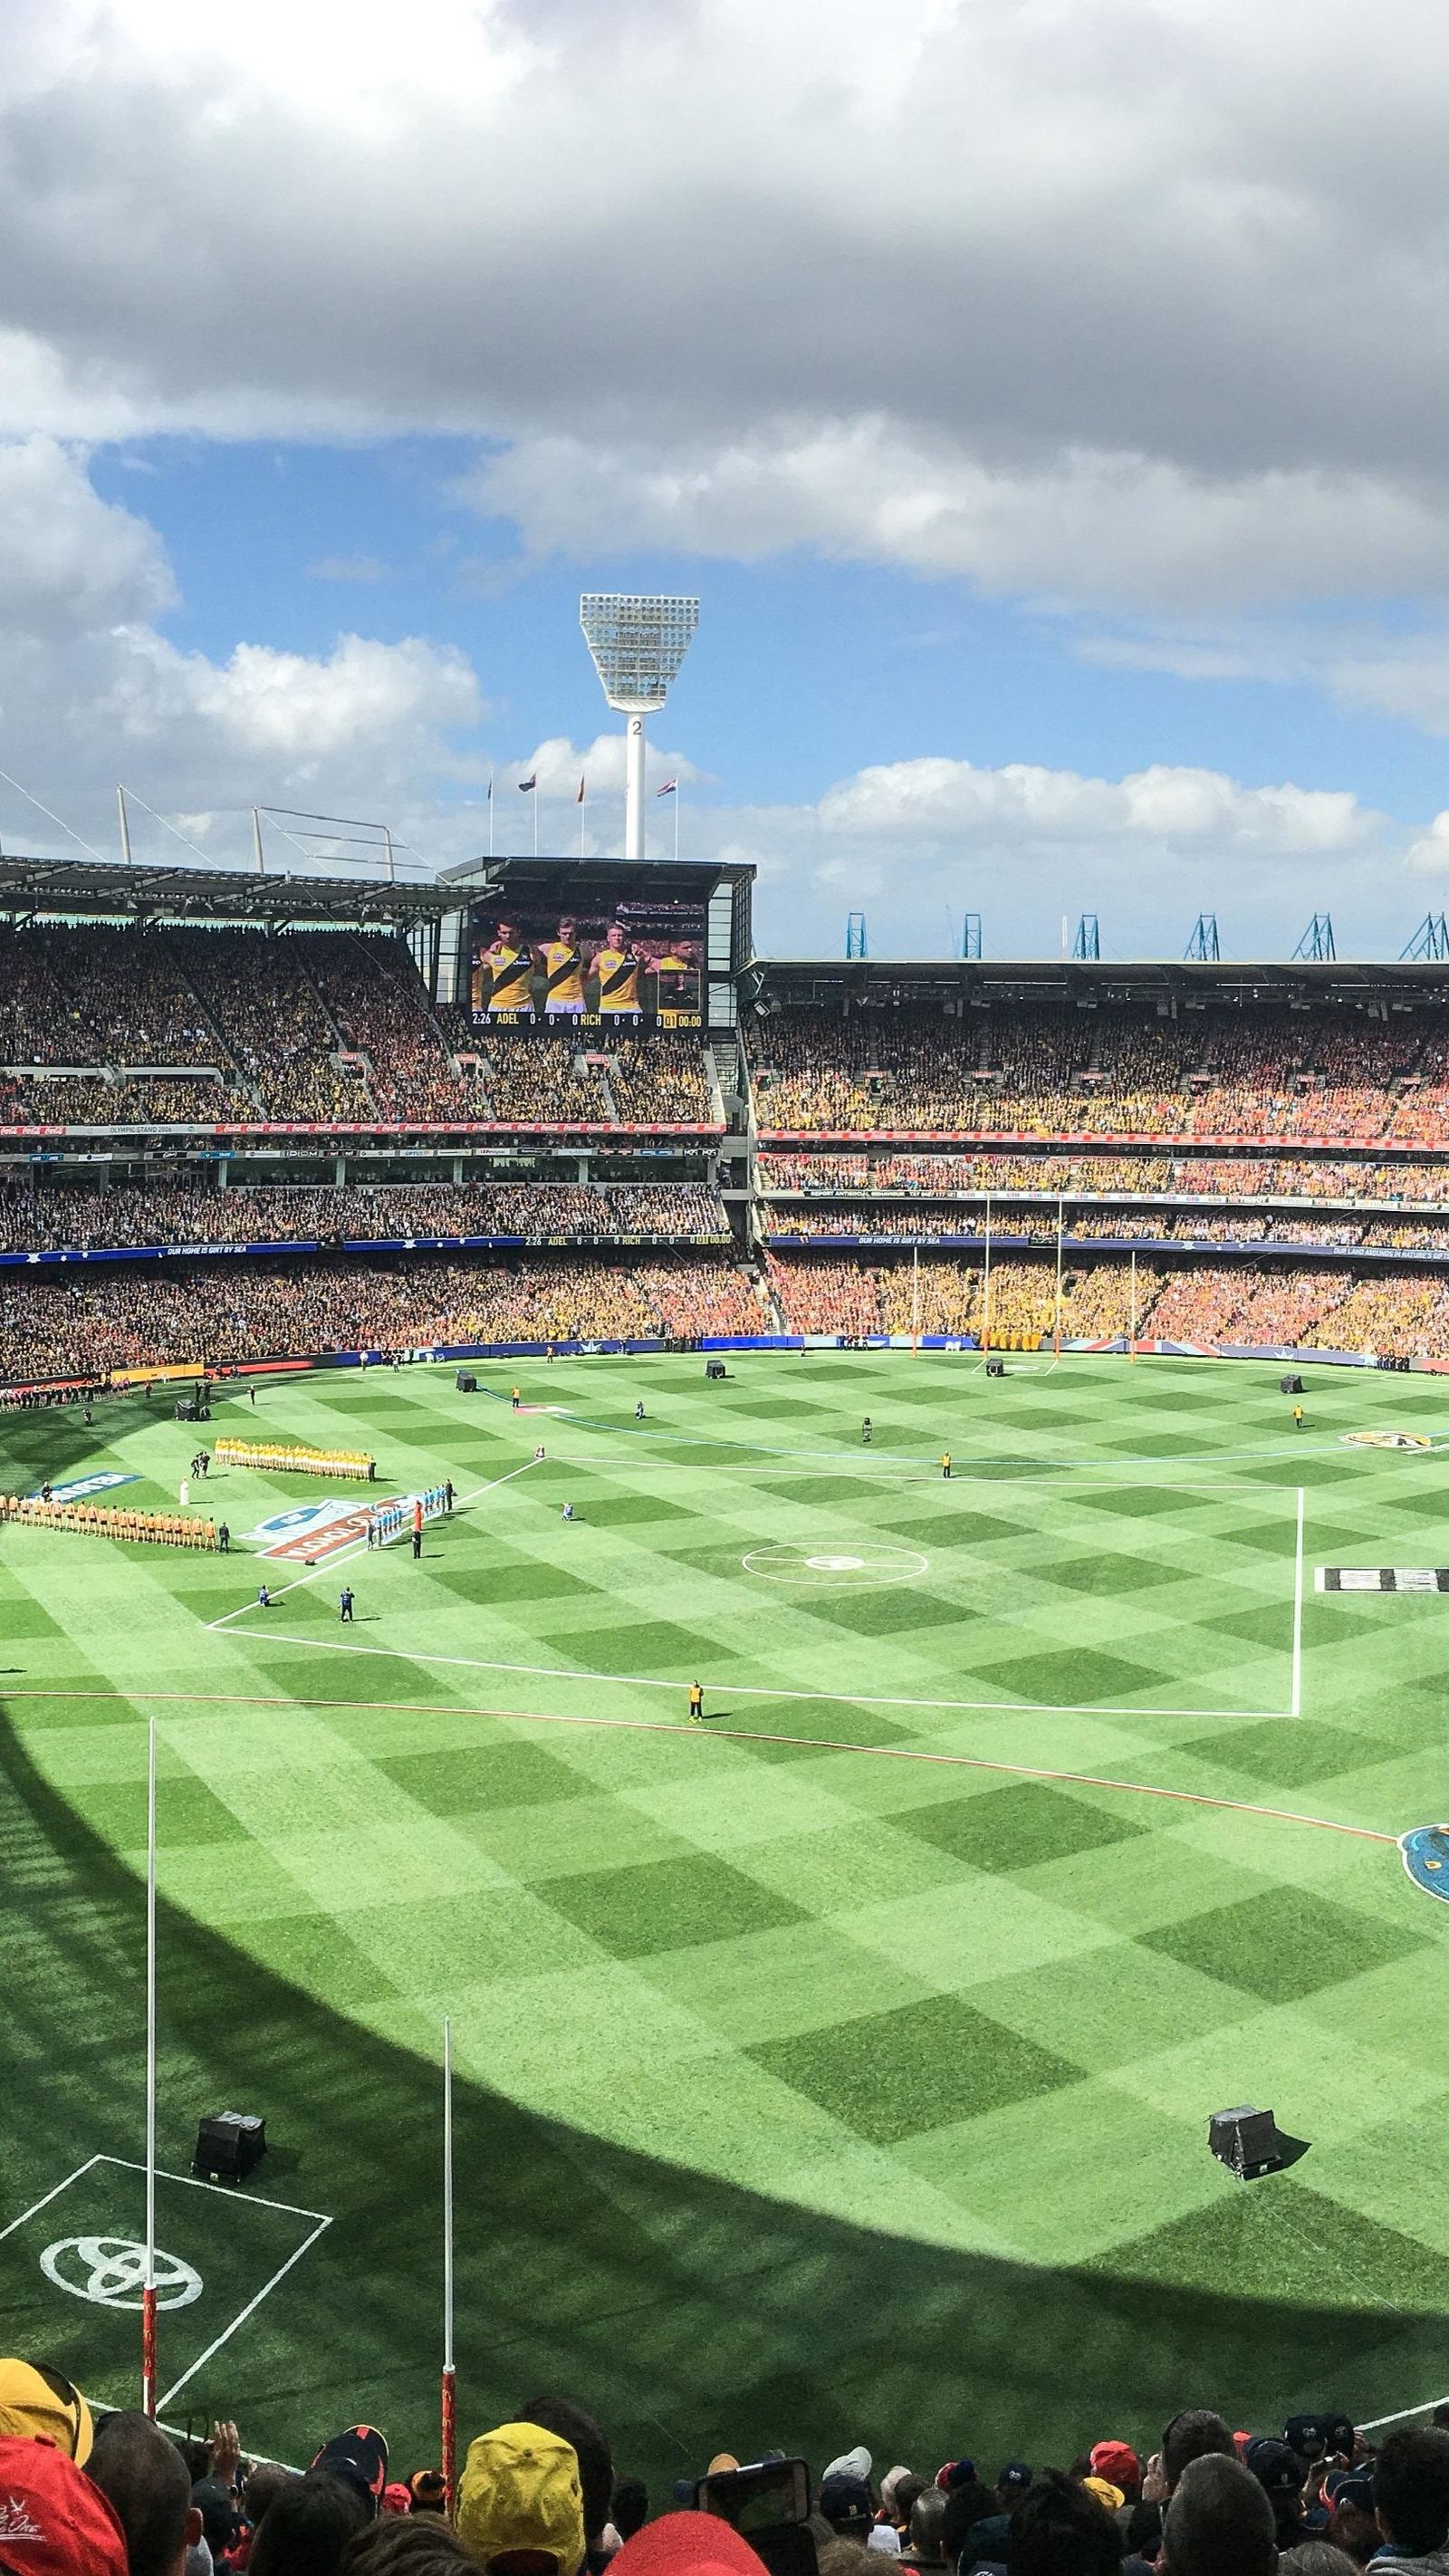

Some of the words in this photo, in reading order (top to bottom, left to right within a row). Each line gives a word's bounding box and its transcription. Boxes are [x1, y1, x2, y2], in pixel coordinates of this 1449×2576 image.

[632, 721, 642, 735] 2
[496, 1013, 519, 1024] ADEL
[530, 1014, 536, 1024] 0
[549, 1014, 555, 1025] 0
[572, 1014, 578, 1025] 0
[581, 1014, 601, 1025] RICH
[614, 1014, 619, 1026] 0
[633, 1015, 638, 1026] 0
[657, 1016, 662, 1027] 0
[666, 1015, 676, 1026] Q1
[678, 1015, 702, 1027] 00:00
[110, 1126, 135, 1134] OLYMPIC
[548, 1237, 568, 1245] ADEL
[1365, 1249, 1394, 1257] ABOUNDS
[279, 1526, 360, 1557] TOYOTA
